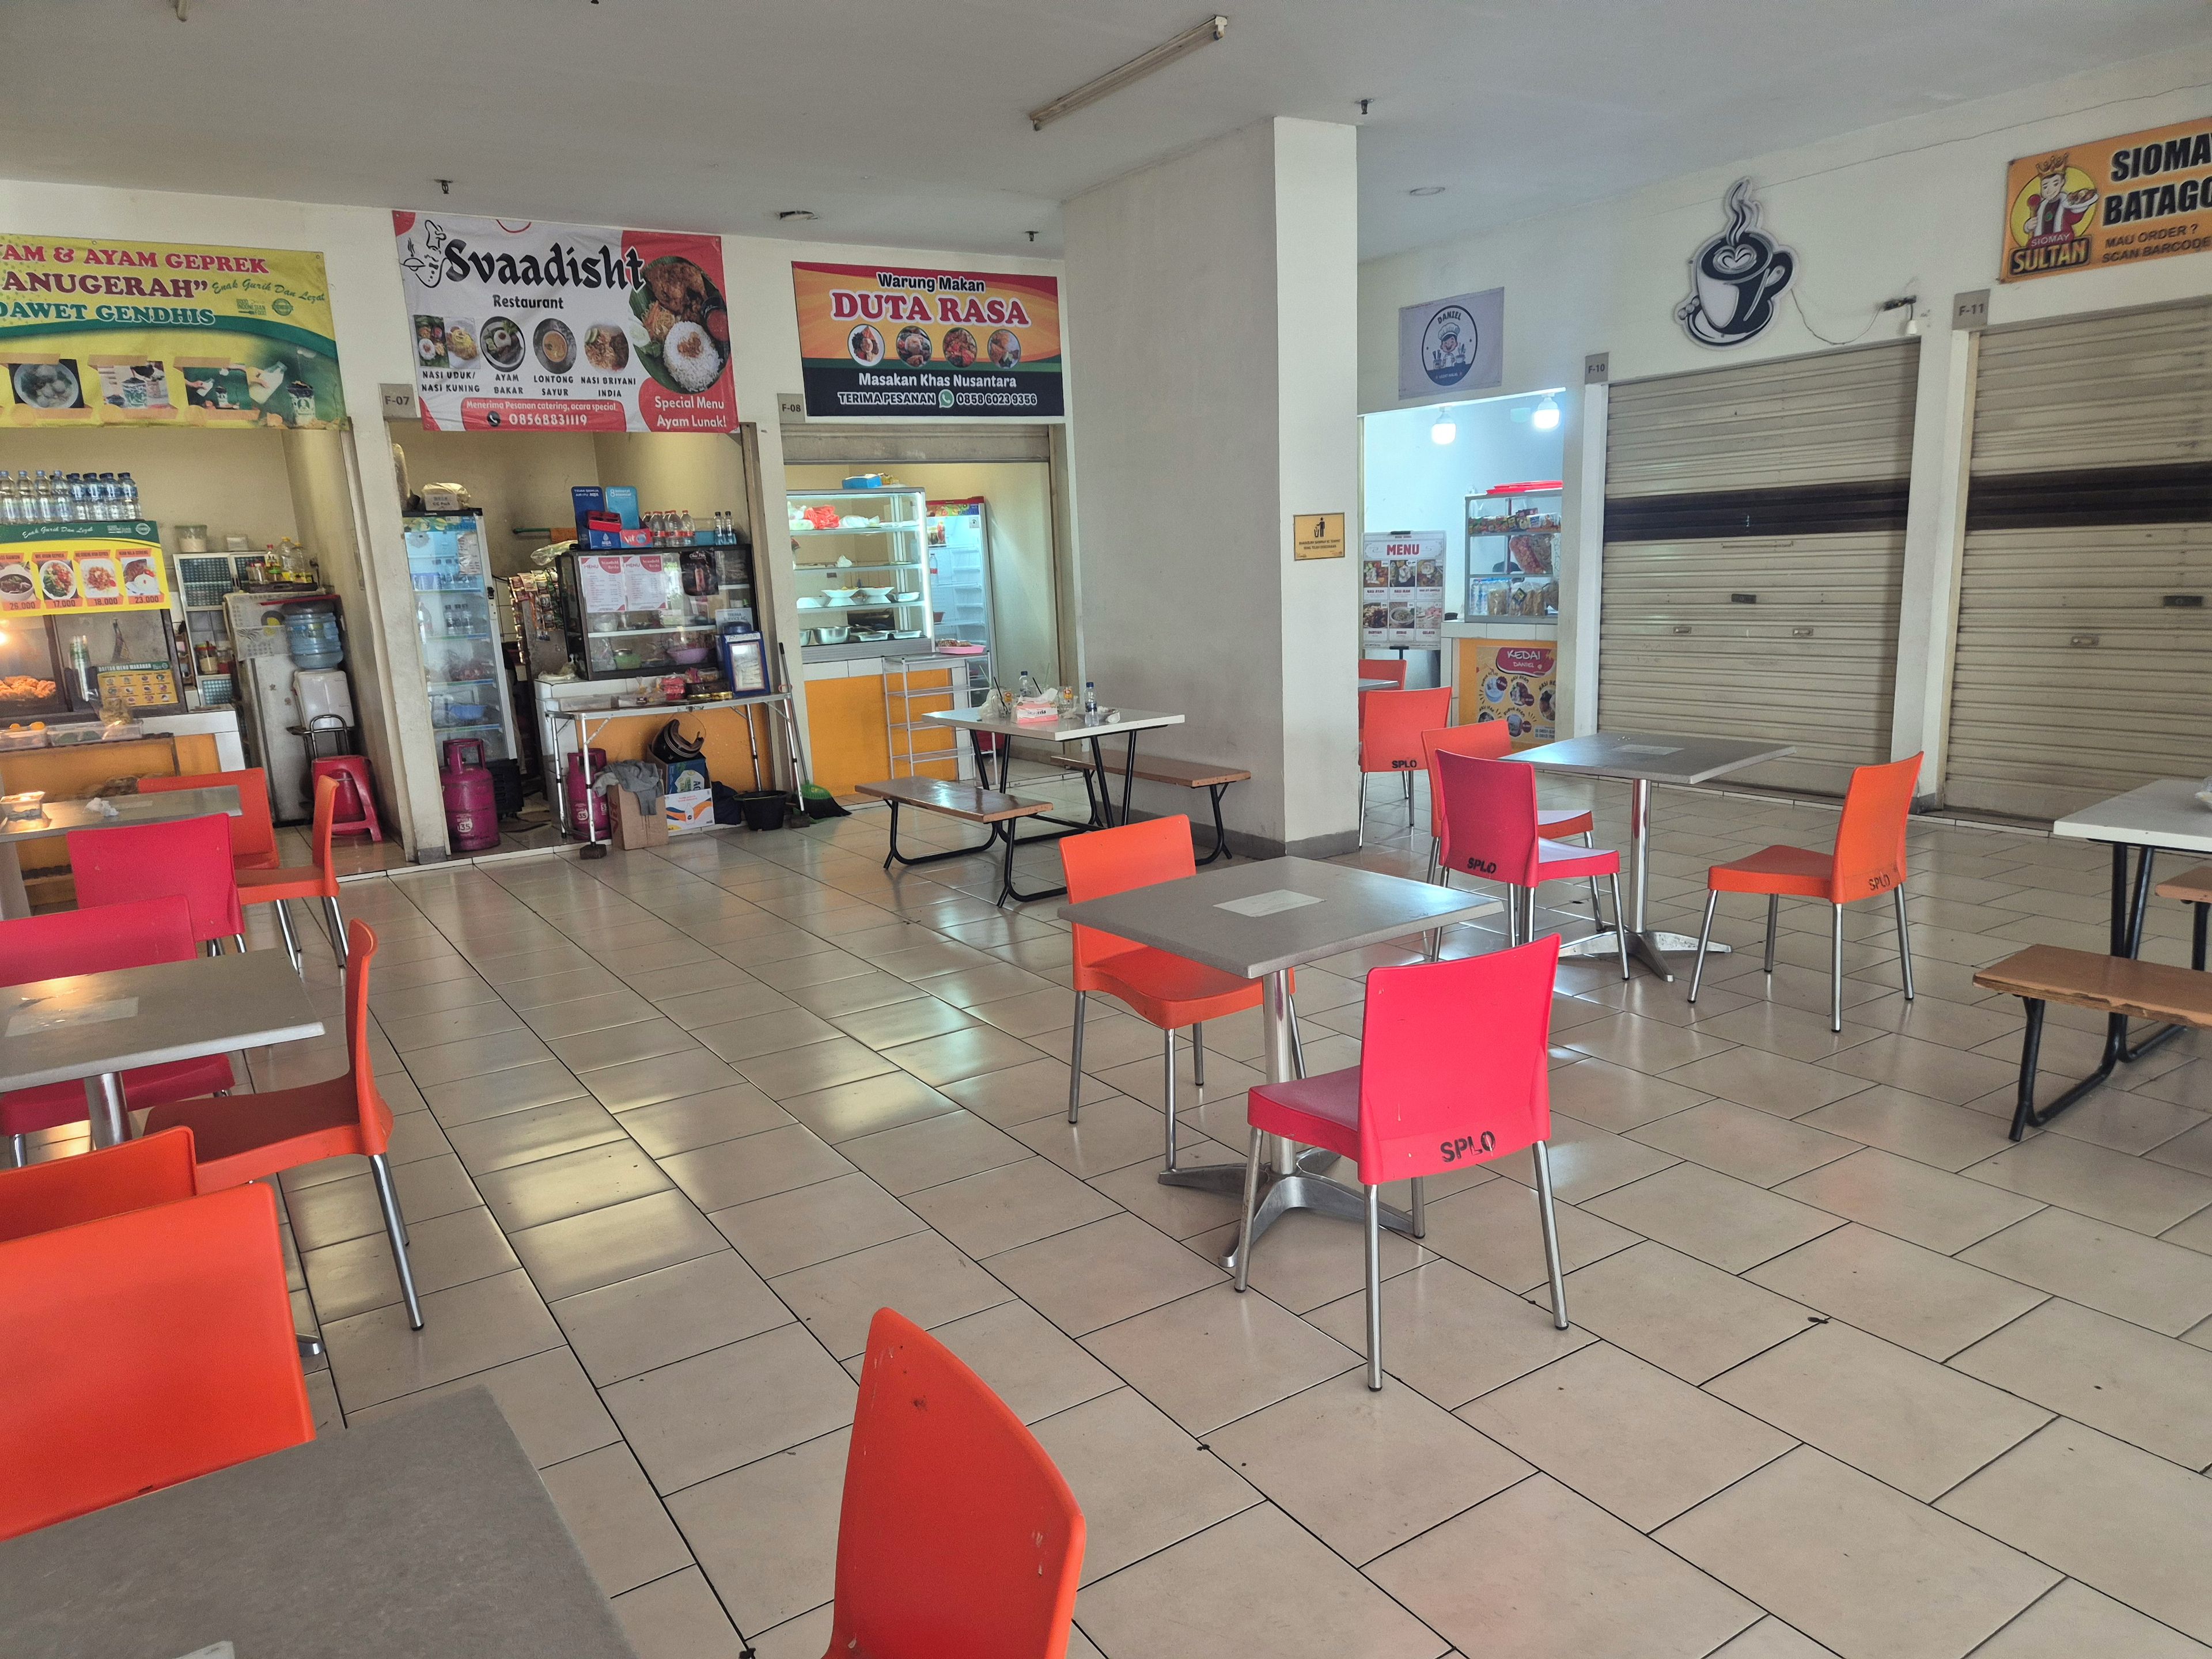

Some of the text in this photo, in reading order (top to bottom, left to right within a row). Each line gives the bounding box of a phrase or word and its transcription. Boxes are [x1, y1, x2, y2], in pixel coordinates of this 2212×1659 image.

[2111, 132, 2212, 182] SIOMA
[2031, 233, 2070, 247] SIOMAY
[2105, 224, 2199, 248] MAU ORDER ?
[0, 244, 270, 274] AM & AYAM GEPREK
[2013, 241, 2088, 274] SULTAN
[2103, 248, 2139, 263] SCAN
[445, 239, 646, 292] Svaadisht
[877, 273, 985, 293] Warung Makan
[211, 278, 325, 304] Enak Gurih Dan Lezat
[493, 294, 564, 309] Restaurant
[832, 292, 1029, 324] DUTA RASA
[95, 304, 215, 325] GENDHIS
[1437, 310, 1462, 324] DANIEL
[1959, 304, 1984, 316] F-11
[422, 371, 443, 379] NASI
[1588, 363, 1605, 373] F-10
[533, 375, 574, 384] LONTONG
[581, 376, 599, 384] NASI
[858, 373, 1017, 388] Masakan Khas Nusantara
[541, 388, 569, 396] SAYUR
[838, 392, 1037, 406] TERIMA PESANAN 0858 6023 9356
[385, 396, 410, 405] F-07
[467, 400, 504, 409] Menerima
[505, 402, 536, 410] Pesanan
[537, 402, 570, 412] catering,
[592, 403, 616, 412] special
[655, 396, 725, 411] Special Menu
[782, 404, 801, 412] F-08
[509, 413, 587, 426] 08568831119
[657, 414, 727, 430] Ayam Lunak!
[610, 489, 615, 497] 8
[1387, 544, 1420, 555] MENU
[10, 602, 36, 610] 26.000
[54, 600, 76, 608] 17.000
[94, 597, 118, 605] 18.000
[135, 596, 159, 604] 23.000
[1508, 650, 1540, 660] KEDAI
[1392, 760, 1417, 768] SPLO
[1467, 857, 1497, 874] SPLO
[1868, 874, 1890, 891] SPLO
[1440, 1131, 1496, 1162] SPLO
